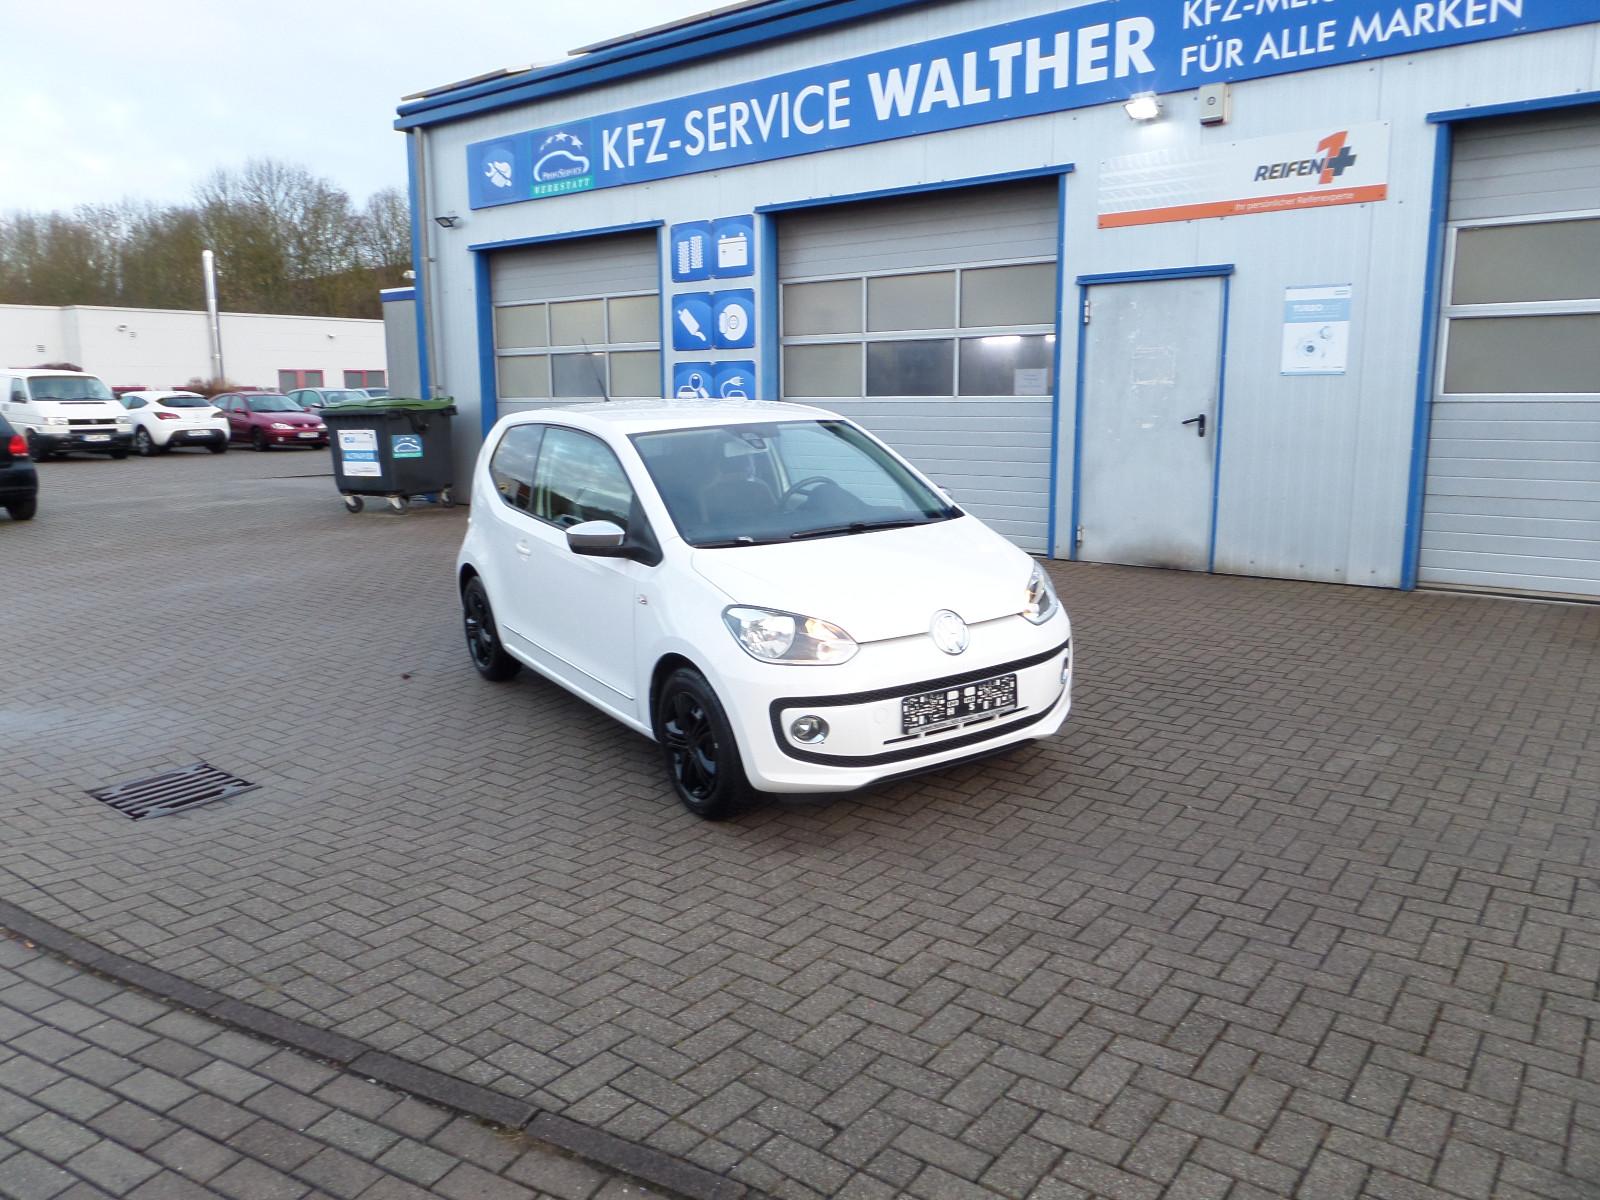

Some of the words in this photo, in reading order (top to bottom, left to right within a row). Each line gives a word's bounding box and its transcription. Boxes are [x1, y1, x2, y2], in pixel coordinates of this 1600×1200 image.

[602, 79, 852, 171] KFZ-SERVICE
[868, 16, 1156, 120] WALTHER
[1180, 34, 1244, 76] FÜR
[1253, 19, 1337, 66] ALLE
[1347, 0, 1523, 48] MARKEN
